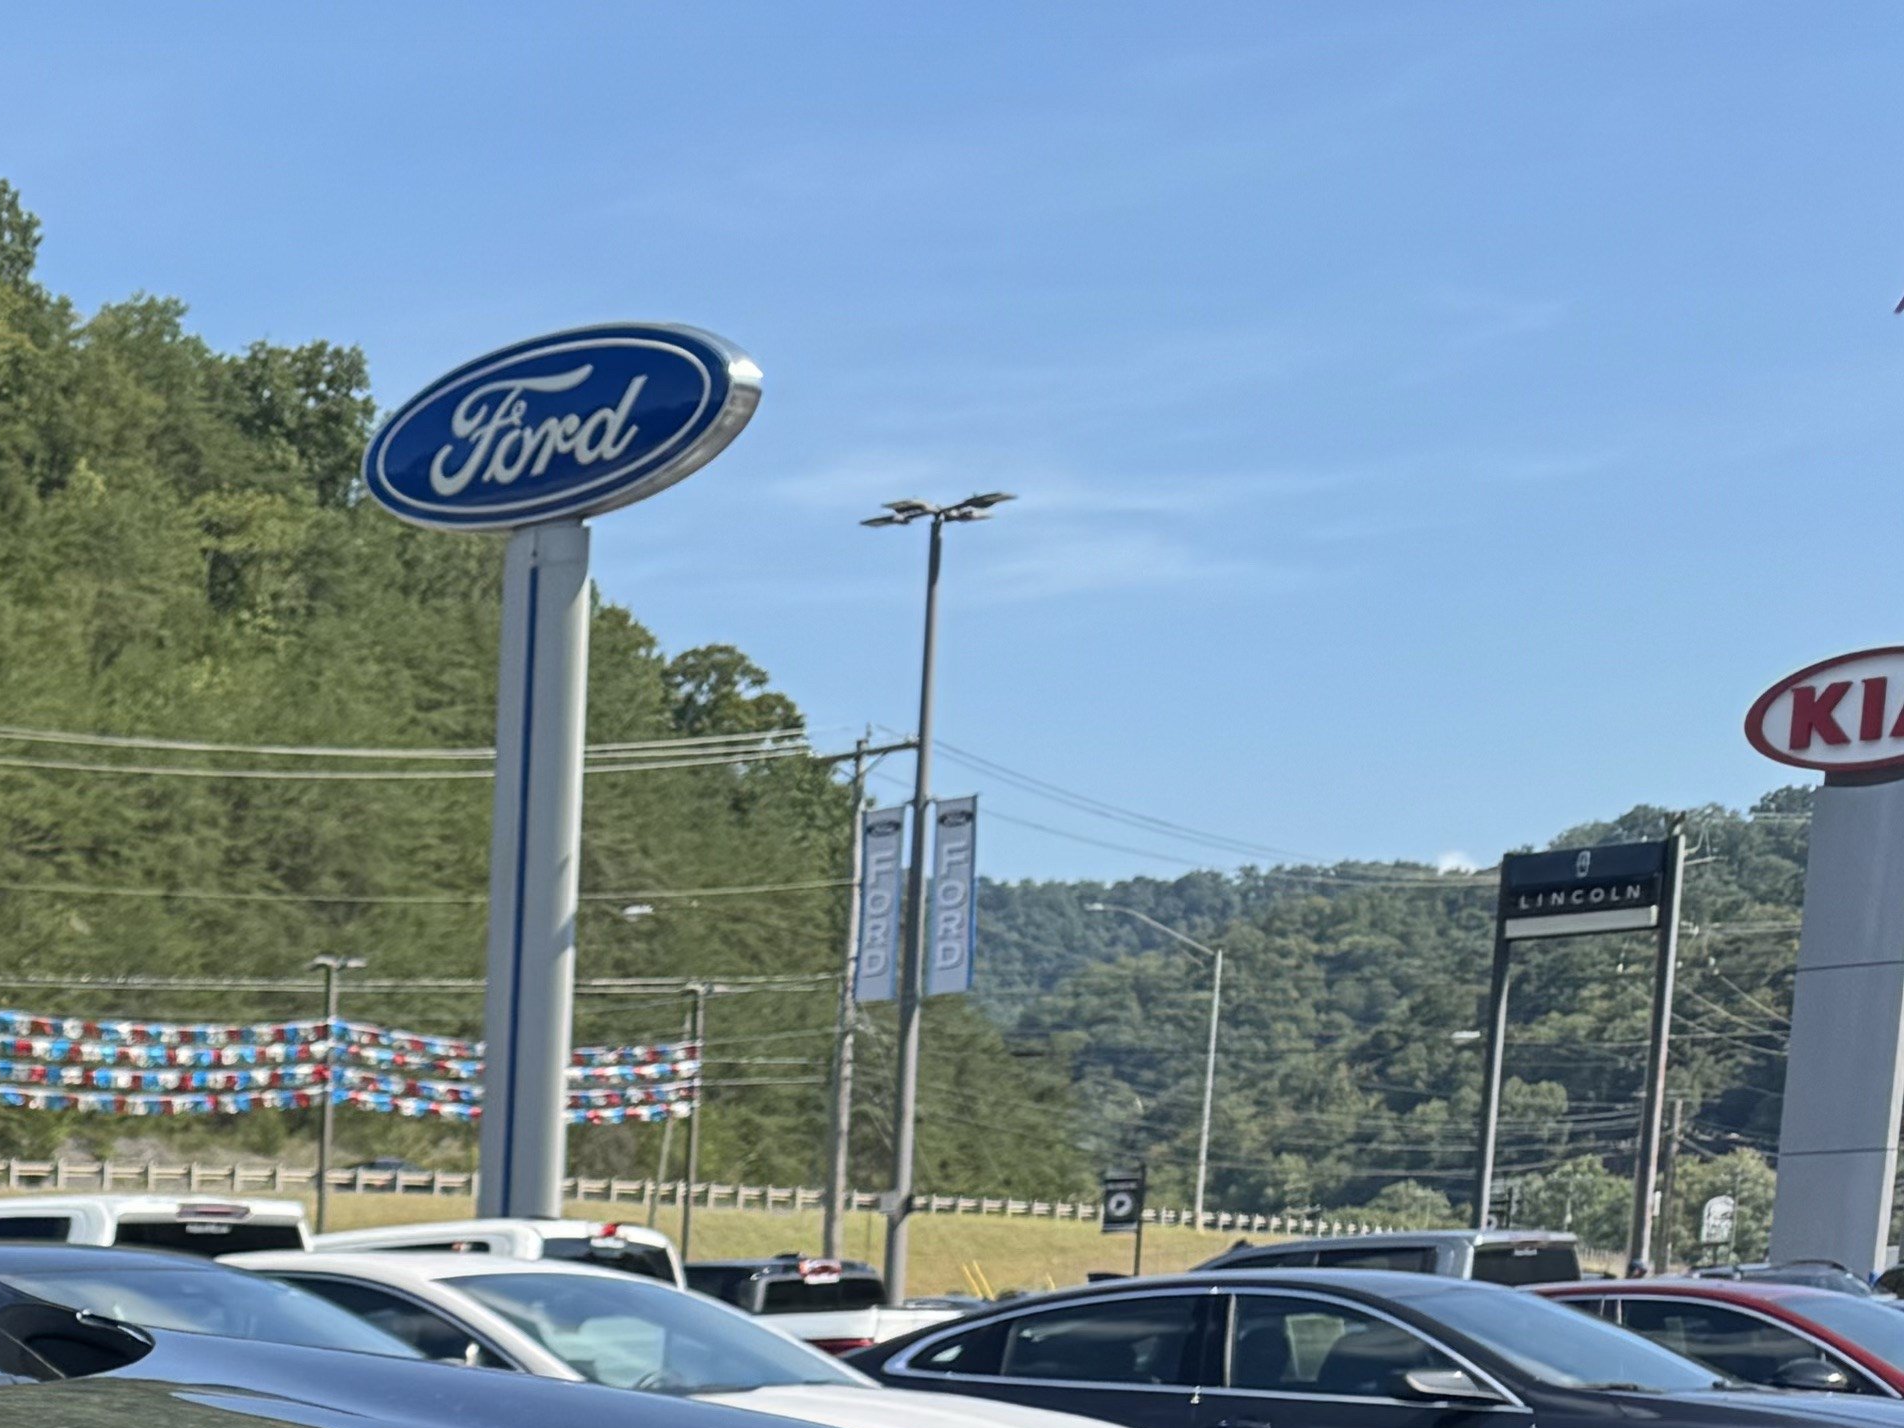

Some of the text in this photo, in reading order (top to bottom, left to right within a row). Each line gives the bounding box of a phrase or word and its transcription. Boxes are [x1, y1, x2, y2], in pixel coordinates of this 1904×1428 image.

[429, 364, 648, 497] Ford
[1788, 676, 1904, 751] KI
[862, 852, 896, 979] FORD
[937, 841, 970, 971] FORD
[1519, 884, 1643, 911] LINCOLN
